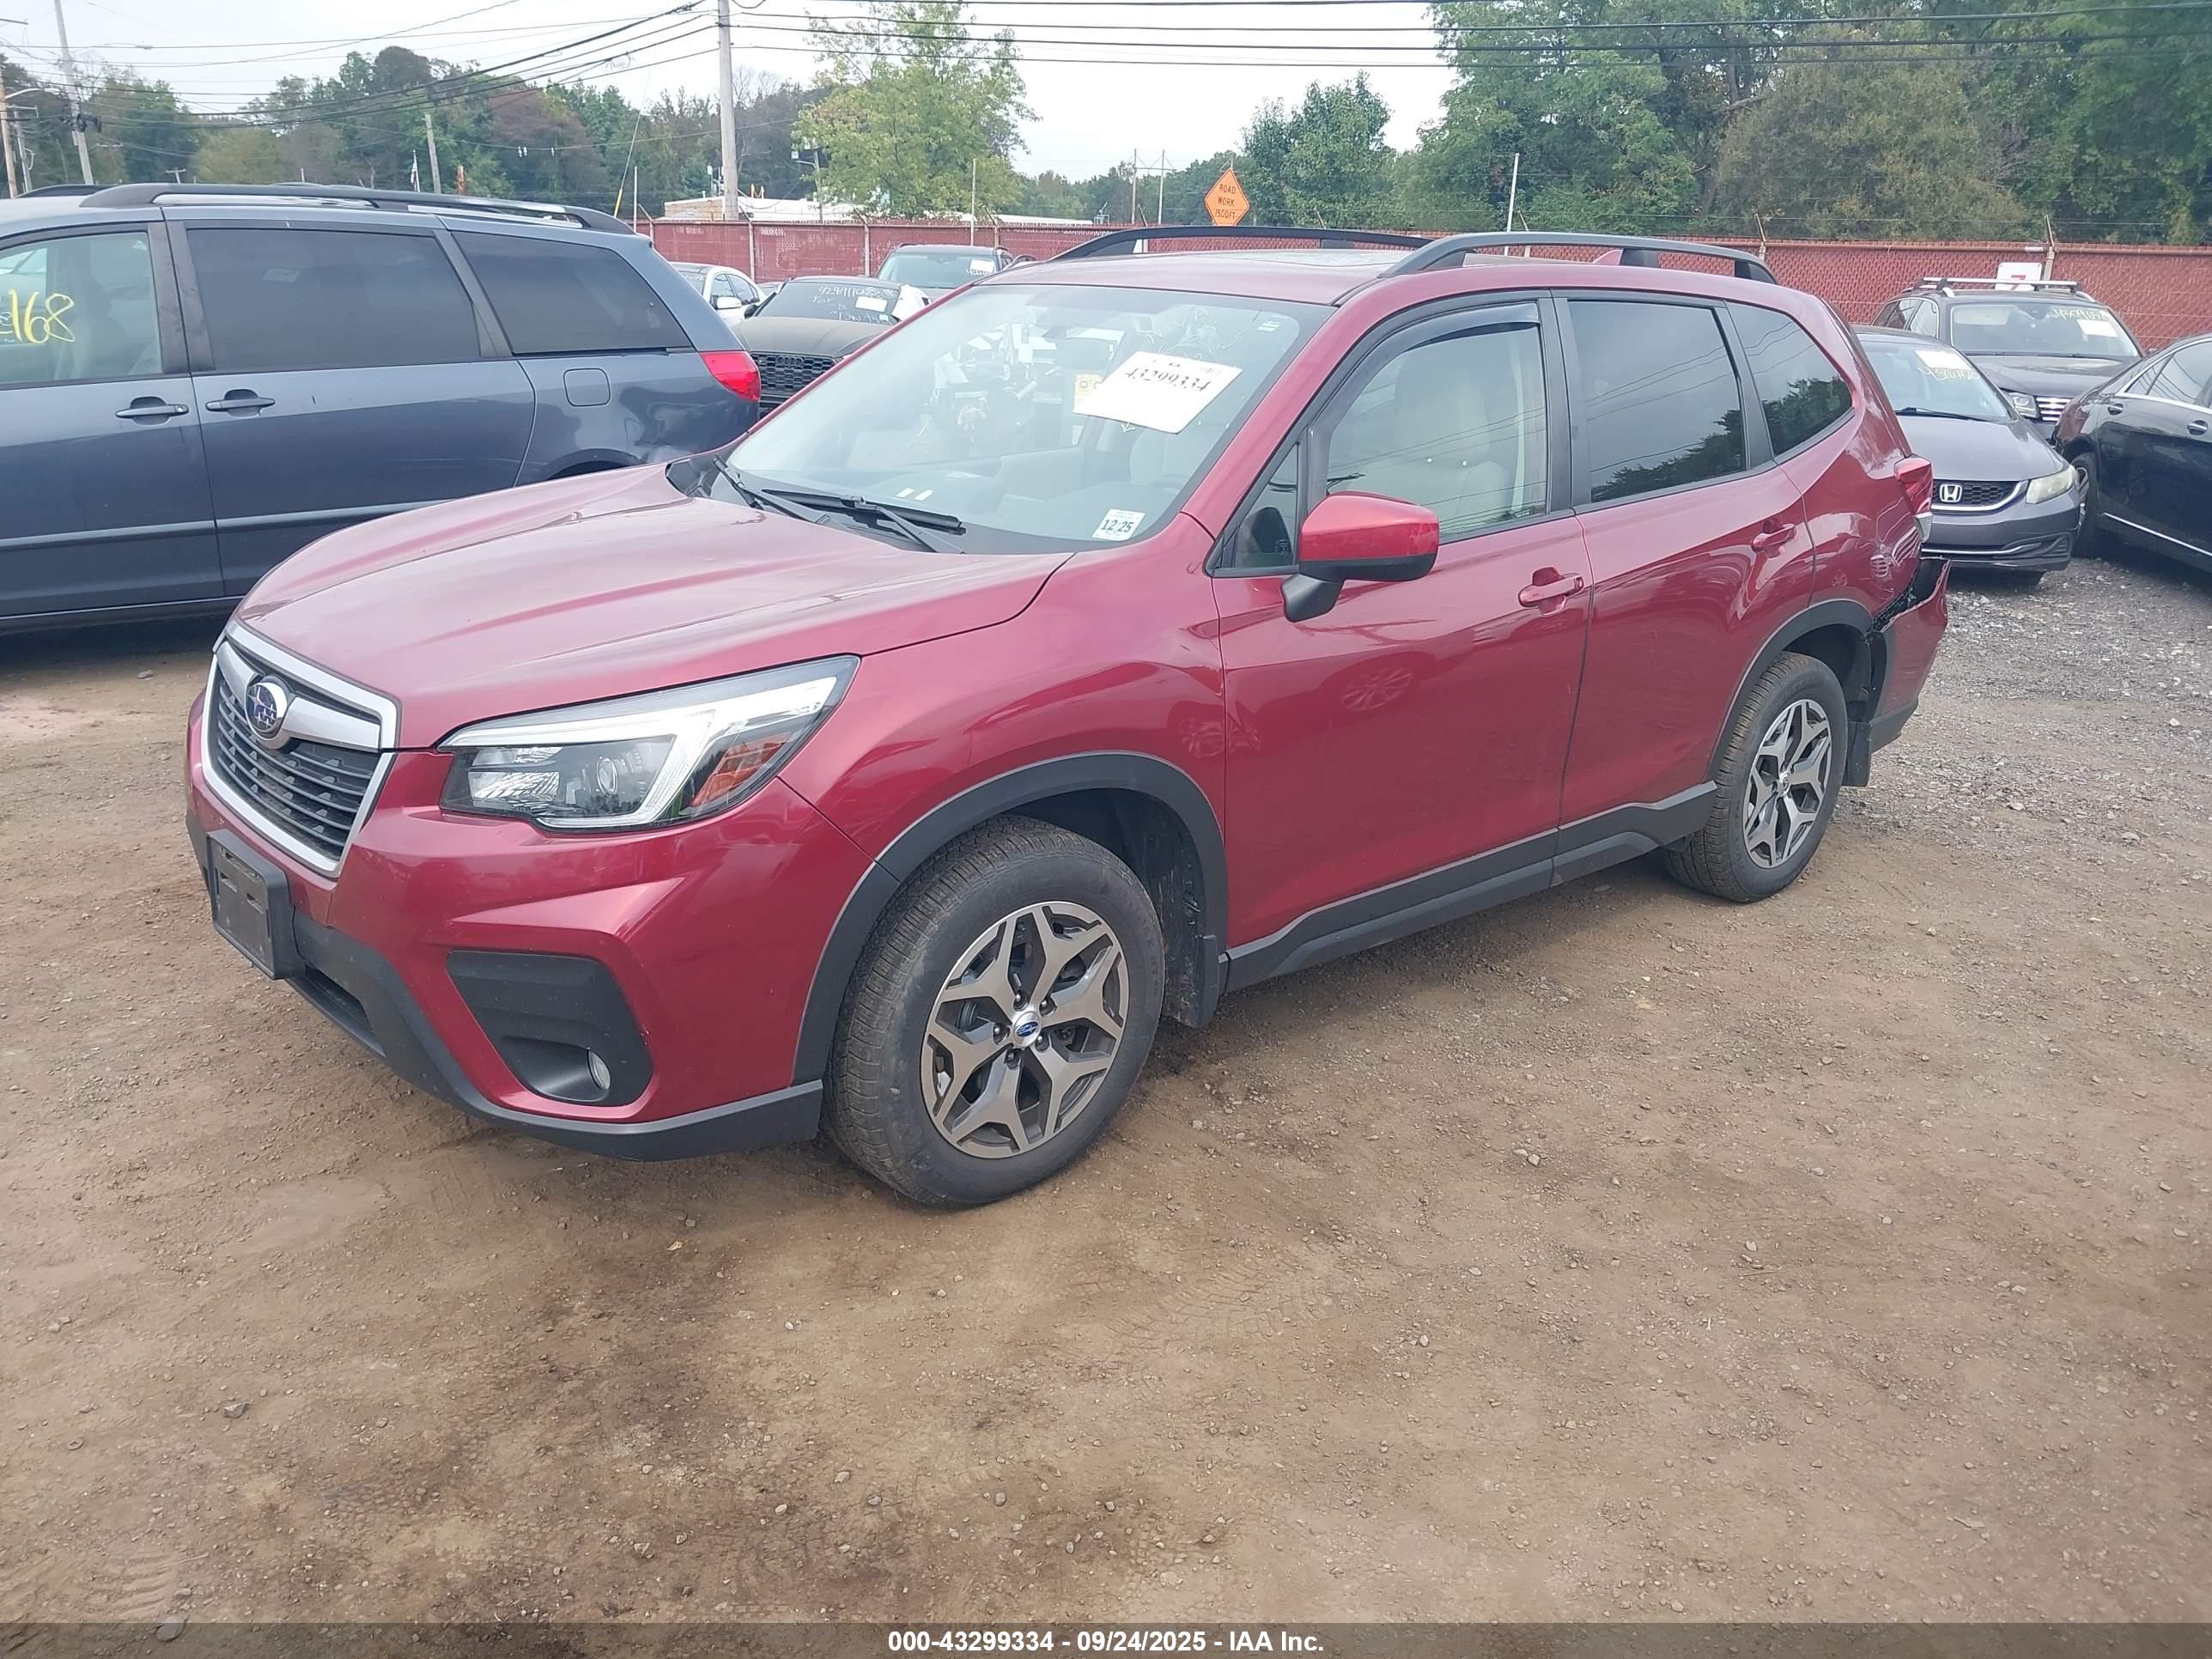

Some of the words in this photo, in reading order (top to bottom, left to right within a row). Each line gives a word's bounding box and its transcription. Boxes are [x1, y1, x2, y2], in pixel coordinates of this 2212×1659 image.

[1218, 183, 1237, 195] ROAD
[1218, 197, 1236, 207] WORK
[1124, 368, 1212, 392] 43299334
[1100, 519, 1118, 531] 12
[1117, 520, 1134, 532] 25
